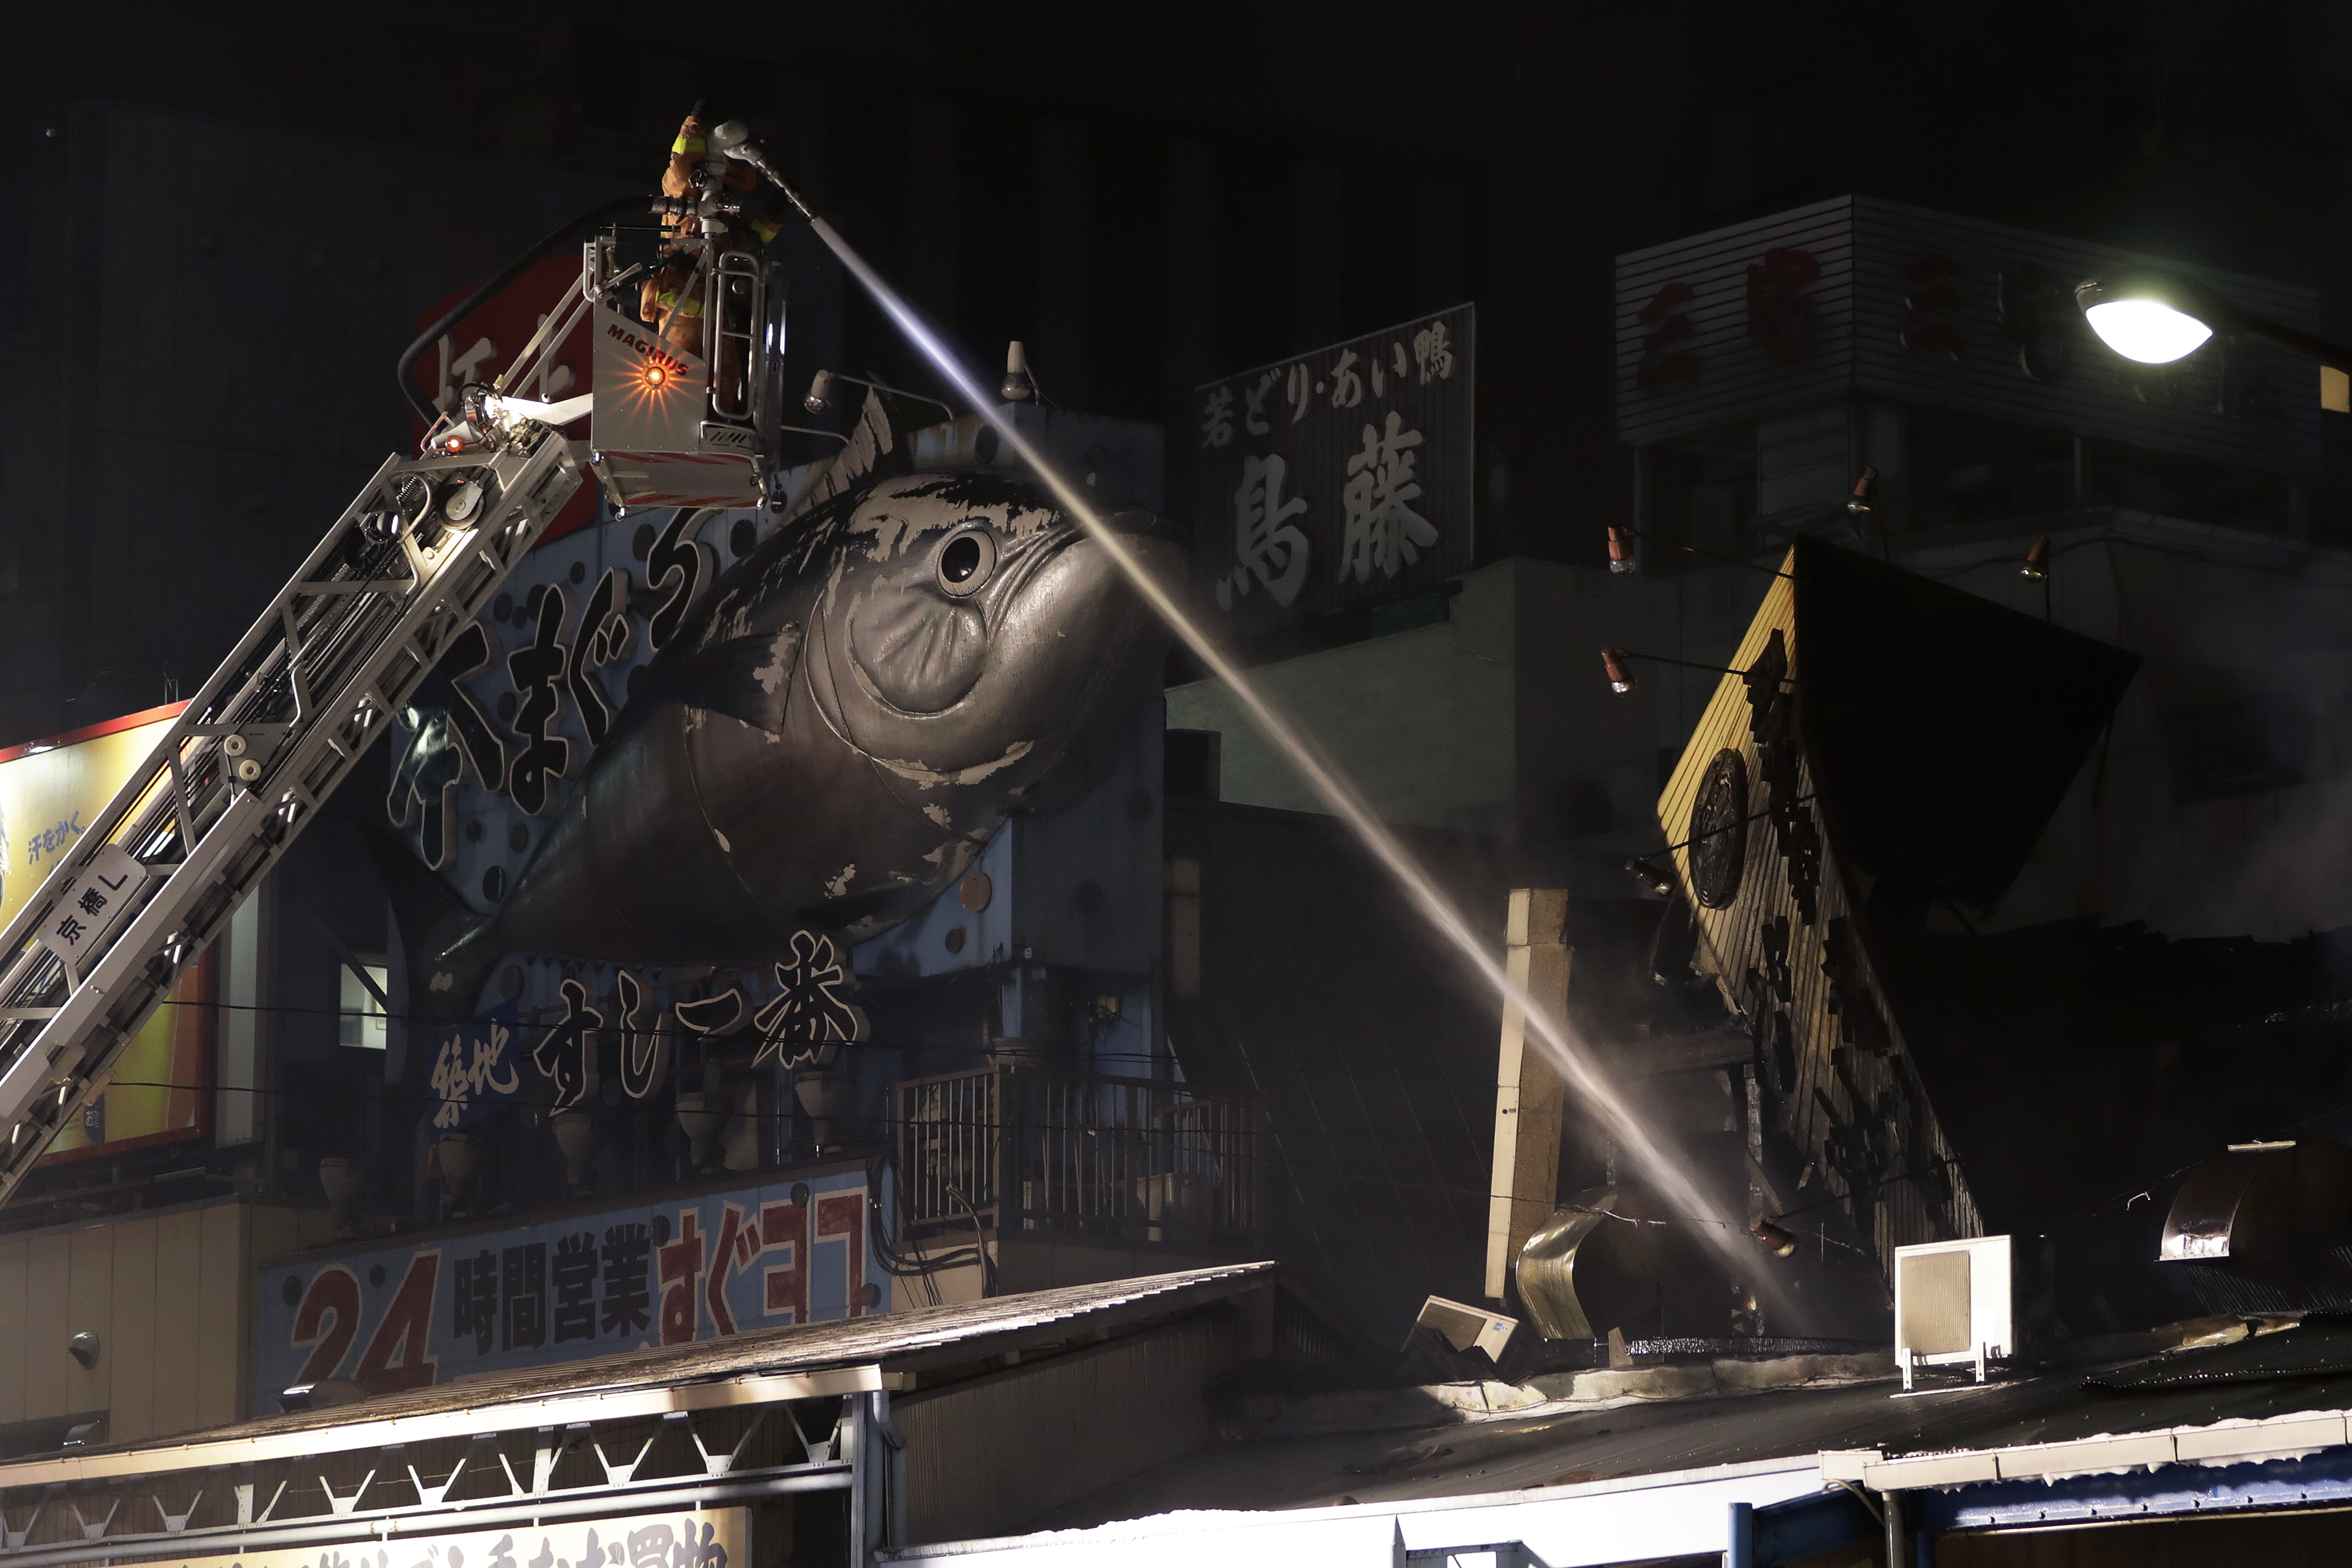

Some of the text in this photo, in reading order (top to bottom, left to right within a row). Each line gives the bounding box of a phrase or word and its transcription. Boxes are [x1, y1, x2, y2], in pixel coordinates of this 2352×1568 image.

[607, 324, 689, 377] MAGIRUS
[1215, 411, 1440, 612] 鳥藤
[431, 1018, 520, 1129] 築地
